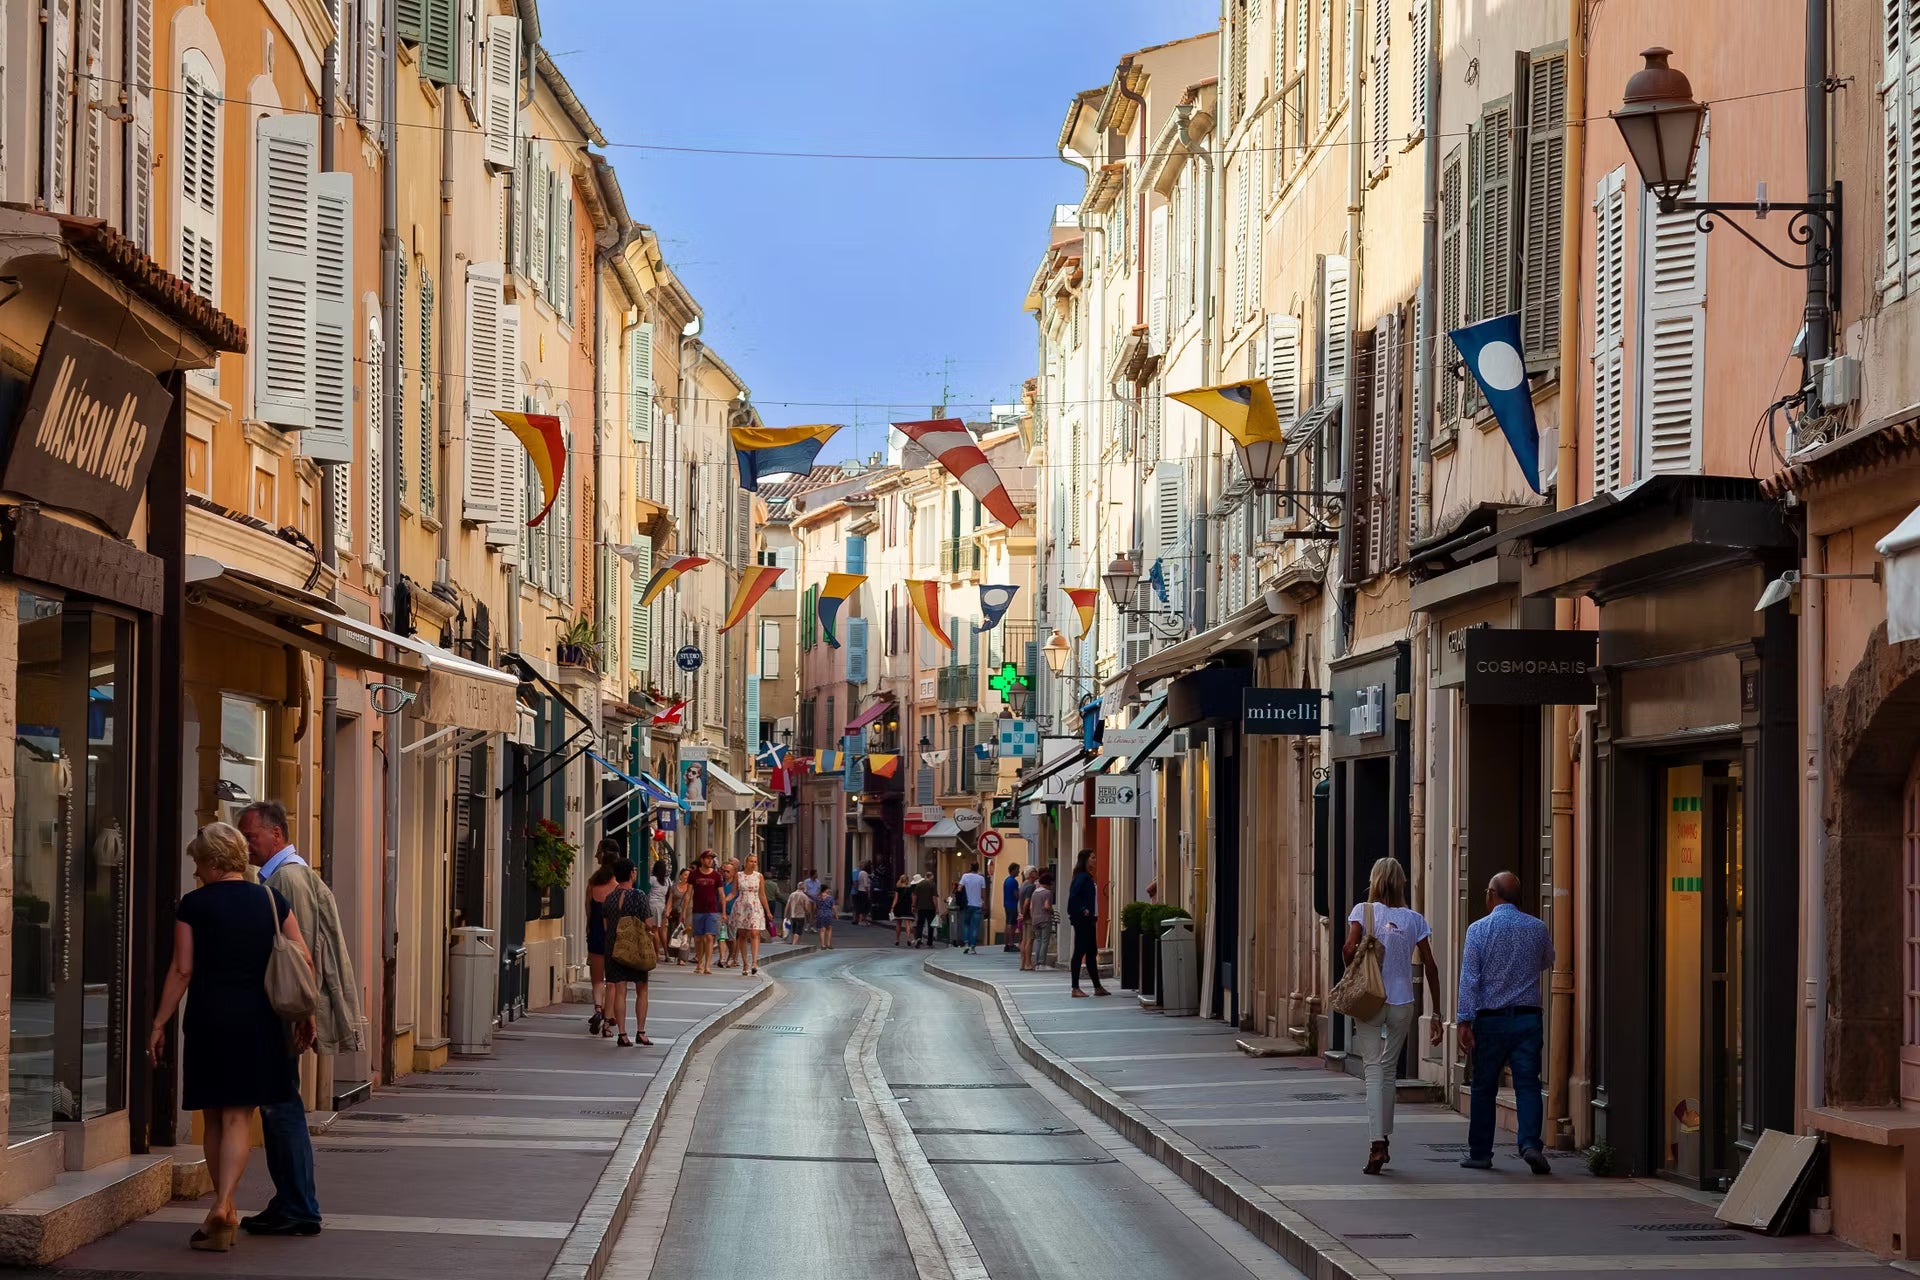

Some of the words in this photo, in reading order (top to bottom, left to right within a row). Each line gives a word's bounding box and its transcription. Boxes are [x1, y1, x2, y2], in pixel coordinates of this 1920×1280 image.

[100, 392, 147, 492] MER
[1476, 659, 1587, 675] COSMOPARIS
[1247, 702, 1320, 721] minelli
[1098, 786, 1117, 796] HERO
[1098, 796, 1117, 805] SEVEN
[956, 814, 982, 823] Casino
